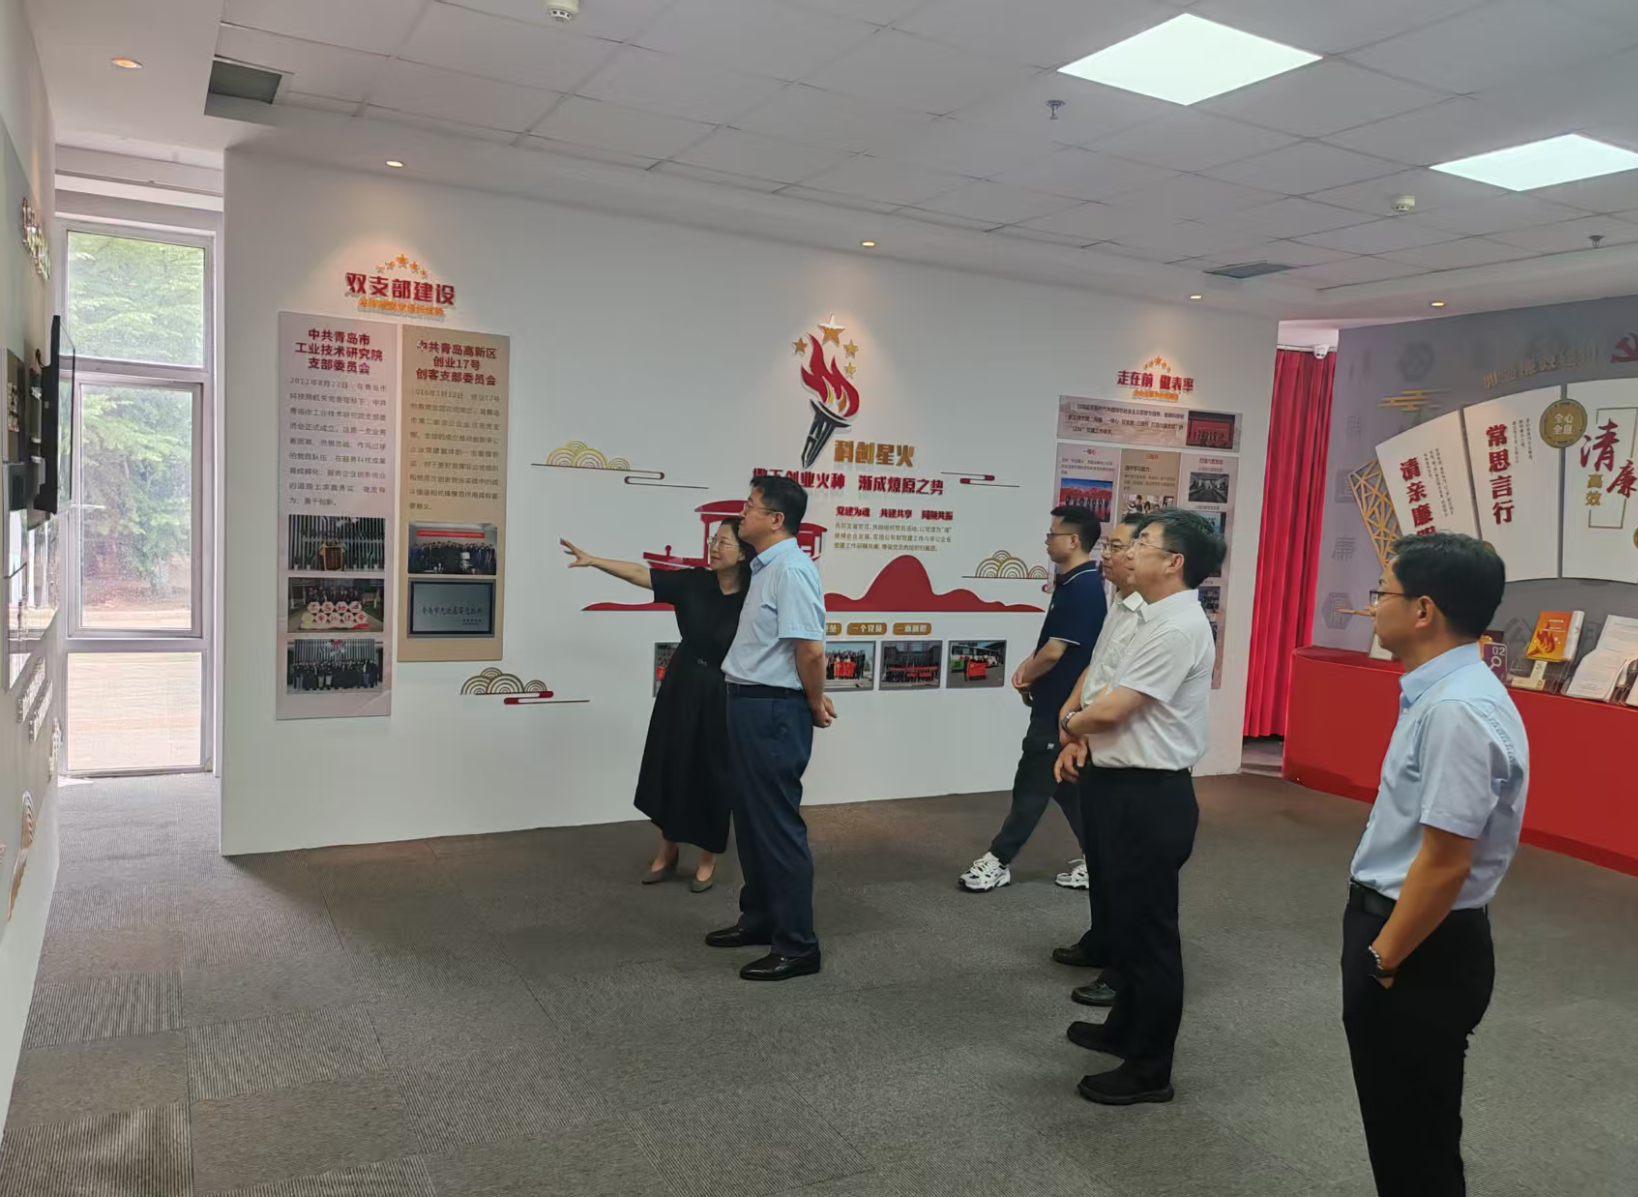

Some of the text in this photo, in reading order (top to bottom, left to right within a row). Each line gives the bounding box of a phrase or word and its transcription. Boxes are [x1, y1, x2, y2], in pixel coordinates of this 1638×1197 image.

[345, 272, 456, 306] 双支部建设
[308, 328, 370, 346] 中共青岛市
[295, 342, 383, 362] 工业技术研究院
[417, 340, 497, 359] 中共青岛高新区
[308, 357, 370, 375] 支部委员会
[433, 355, 480, 371] 创业17号
[416, 367, 496, 386] 创客支部委员会
[1117, 370, 1154, 388] 走在前
[834, 440, 915, 467] 科创星火
[1580, 418, 1637, 498] 清廉
[1486, 423, 1515, 525] 常思言行
[858, 475, 944, 496] 渐成燎原之势
[1400, 456, 1436, 535] 清亲廉
[879, 508, 912, 519] 共建共享
[1492, 646, 1506, 656] 02
